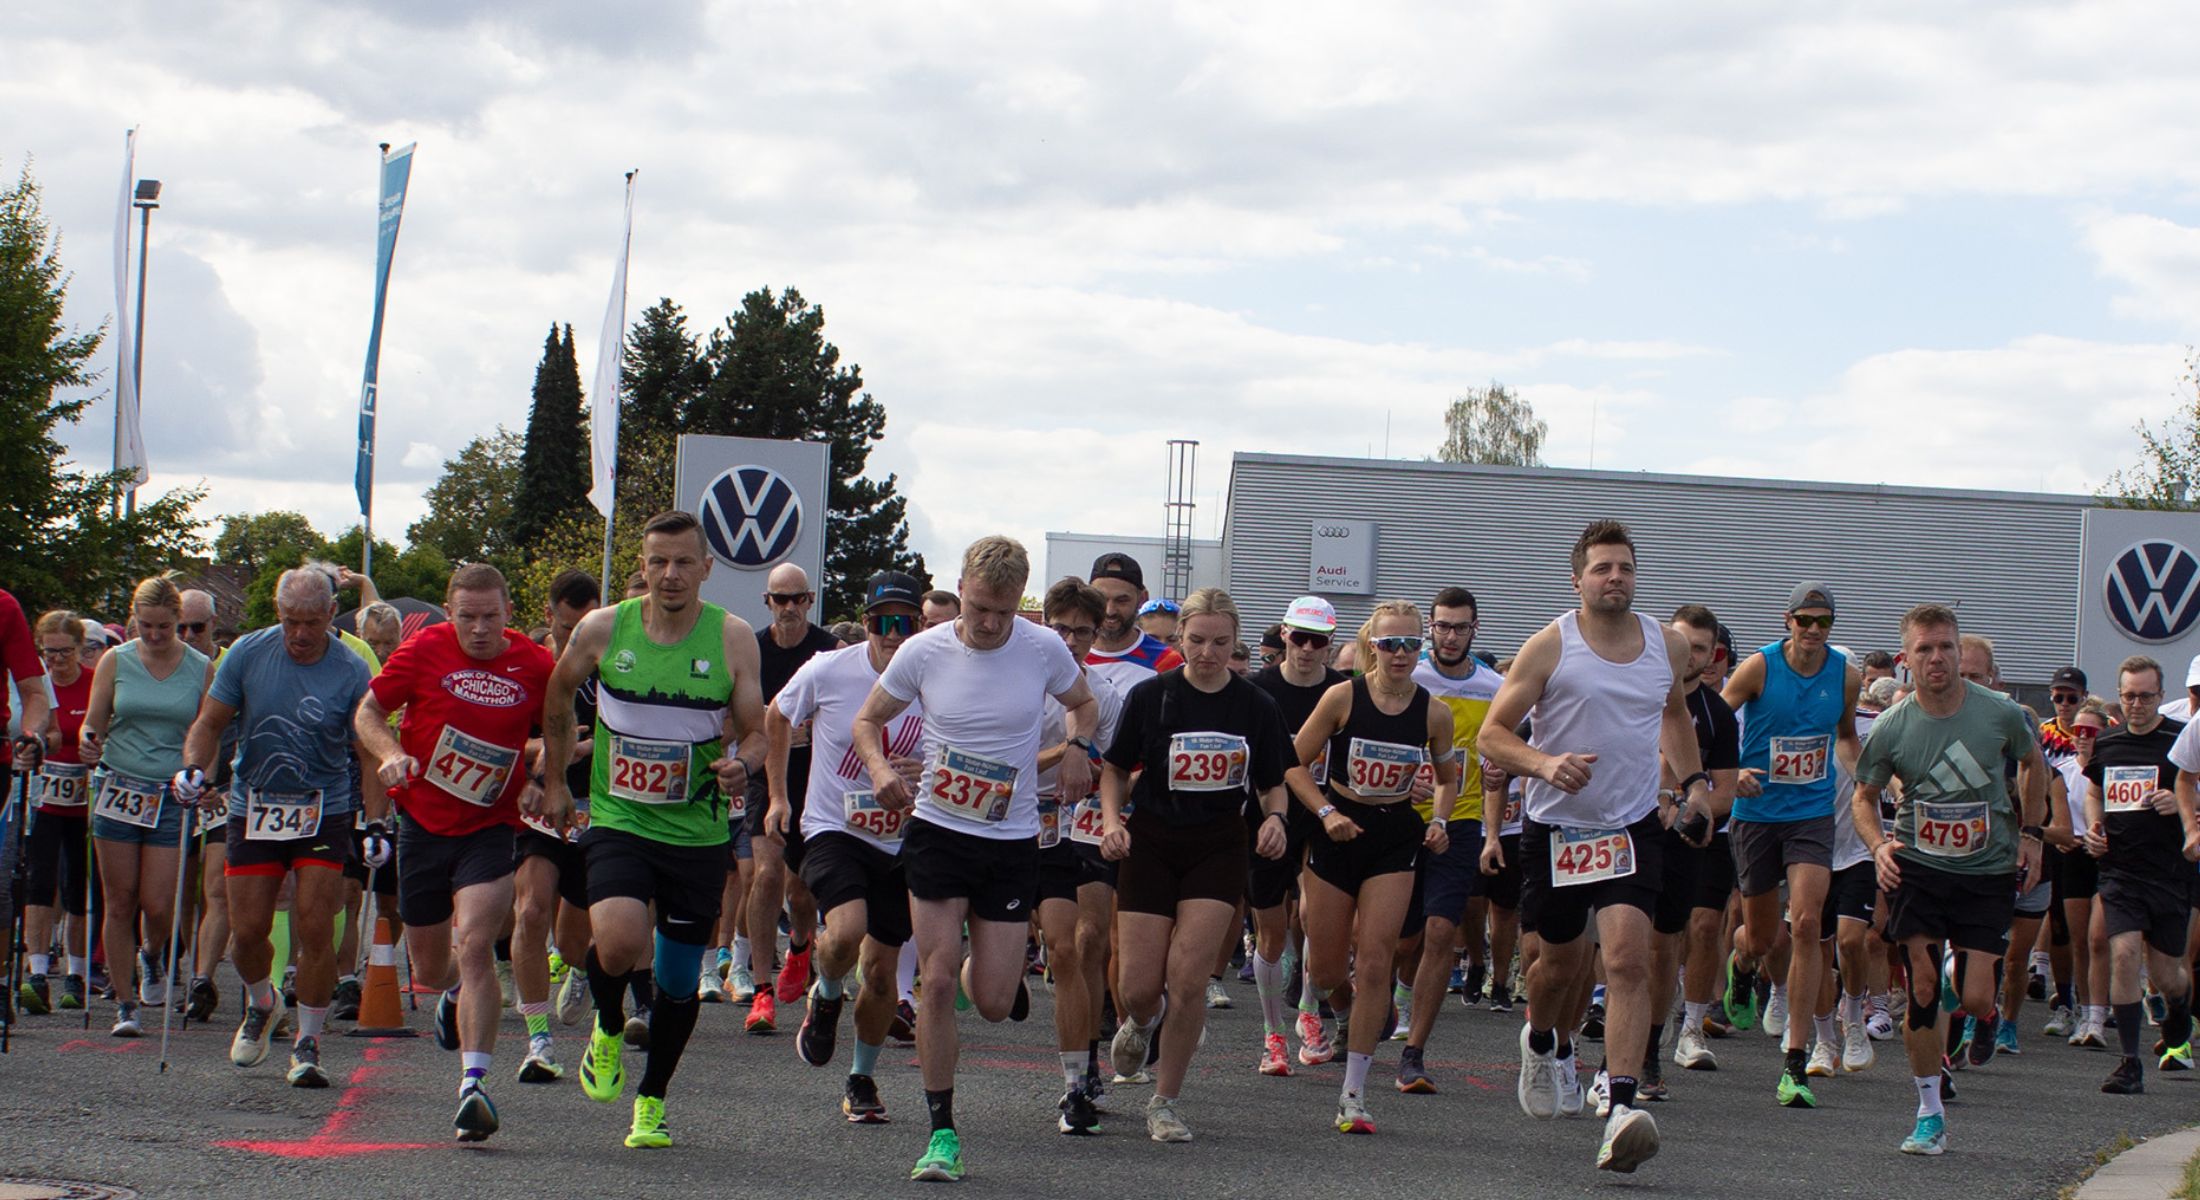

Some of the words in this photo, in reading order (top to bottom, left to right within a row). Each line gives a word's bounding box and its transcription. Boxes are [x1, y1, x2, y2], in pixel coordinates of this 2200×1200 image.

[1316, 576, 1360, 587] Service
[1317, 565, 1346, 575] Audi
[453, 672, 475, 680] BANK
[461, 679, 510, 696] CHICAGO
[454, 684, 516, 704] MARATHON
[435, 751, 493, 791] 477
[615, 758, 667, 792] 282
[1174, 754, 1228, 781] 239
[1353, 759, 1402, 788] 305
[1775, 753, 1813, 776] 213
[42, 776, 74, 798] 719
[934, 769, 992, 809] 237
[2108, 782, 2142, 803] 460
[104, 788, 143, 816] 743
[253, 807, 302, 832] 734
[1919, 820, 1968, 848] 479
[1557, 840, 1611, 875] 425
